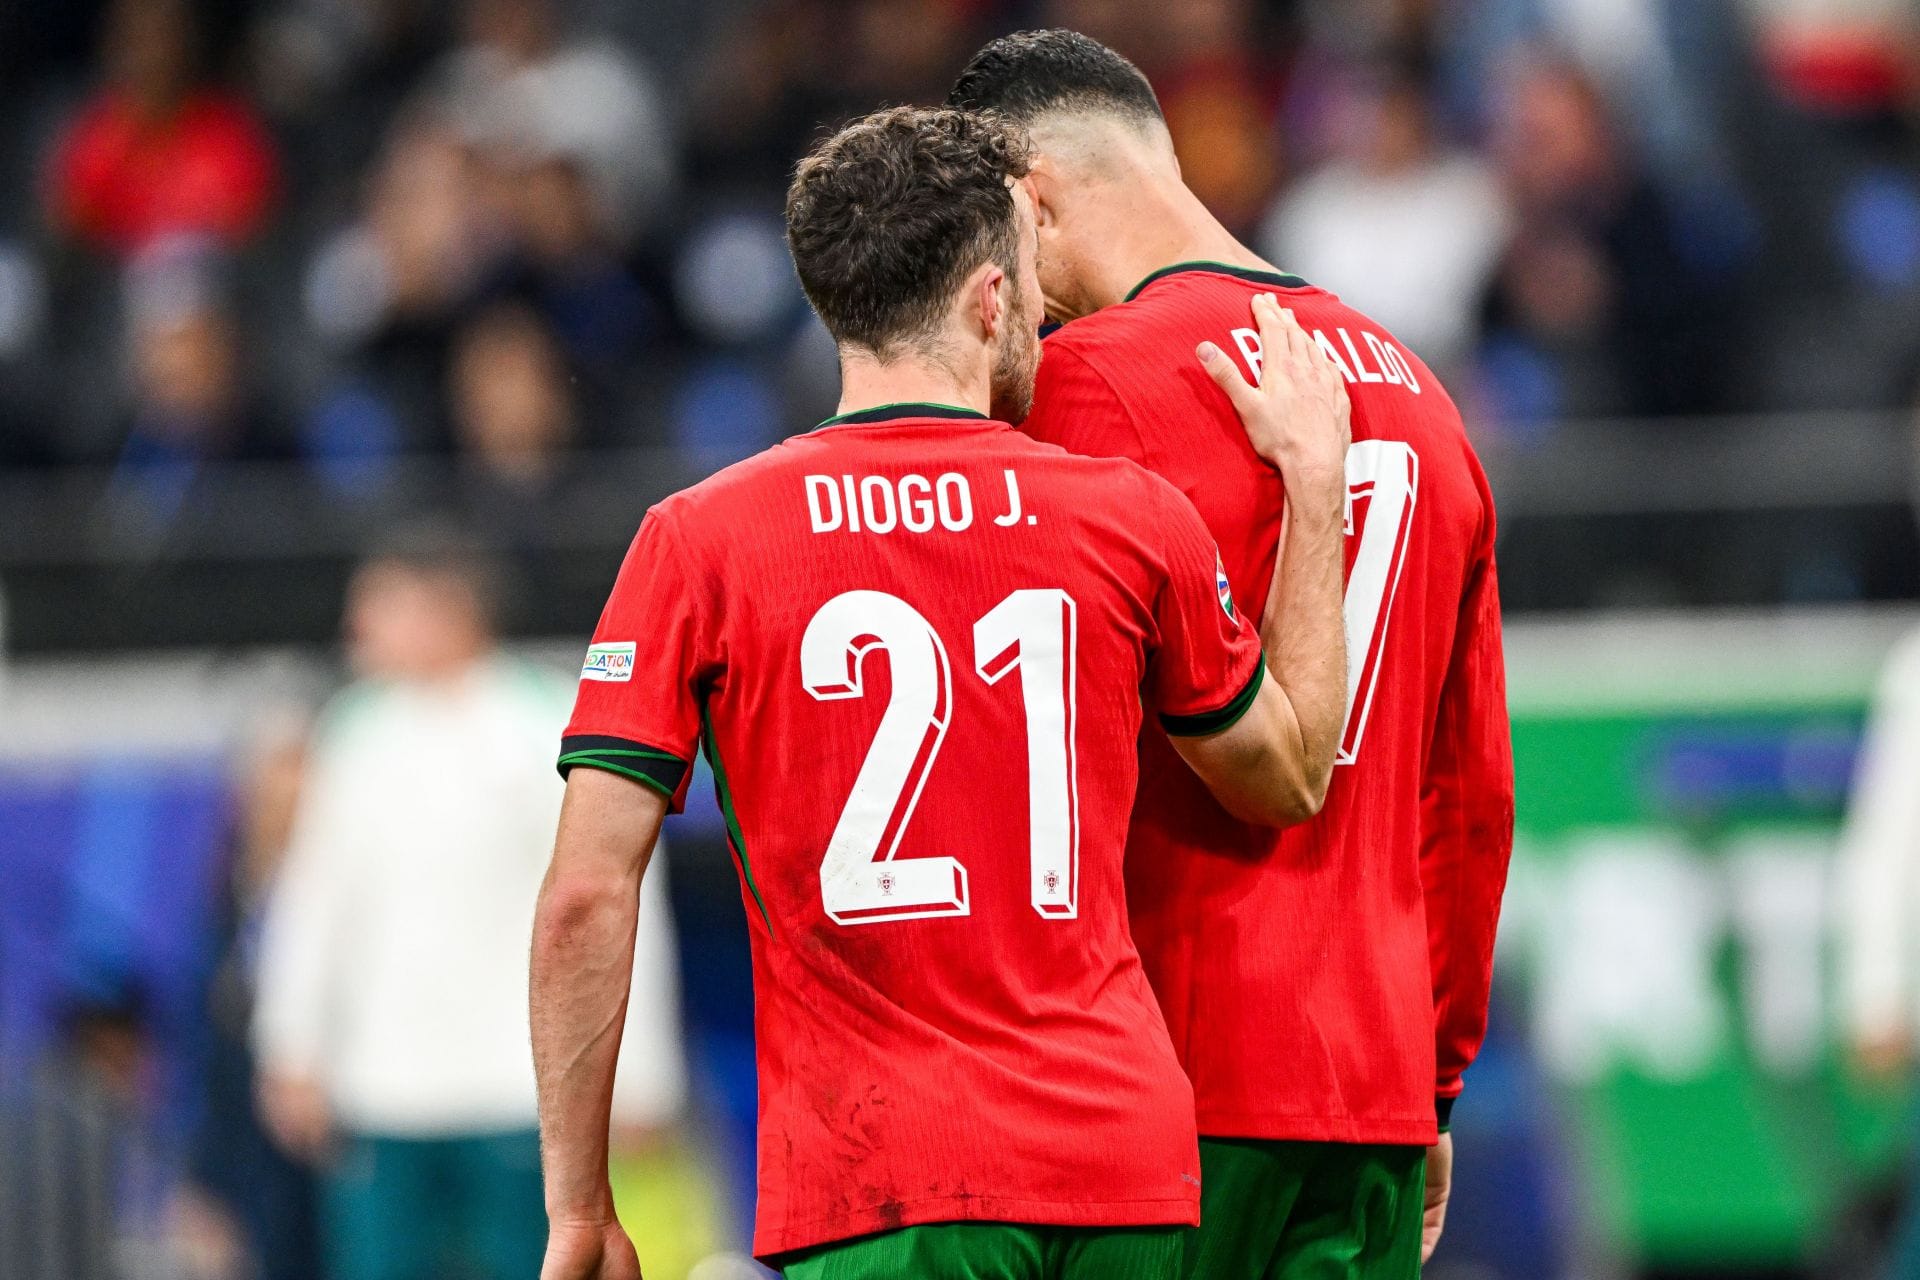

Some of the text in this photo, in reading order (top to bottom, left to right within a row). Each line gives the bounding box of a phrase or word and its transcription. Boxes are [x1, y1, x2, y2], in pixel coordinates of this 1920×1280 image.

[1231, 327, 1421, 395] RALDO
[804, 469, 1038, 535] DIOGO J.
[1334, 439, 1419, 766] 7
[800, 588, 1077, 926] 21
